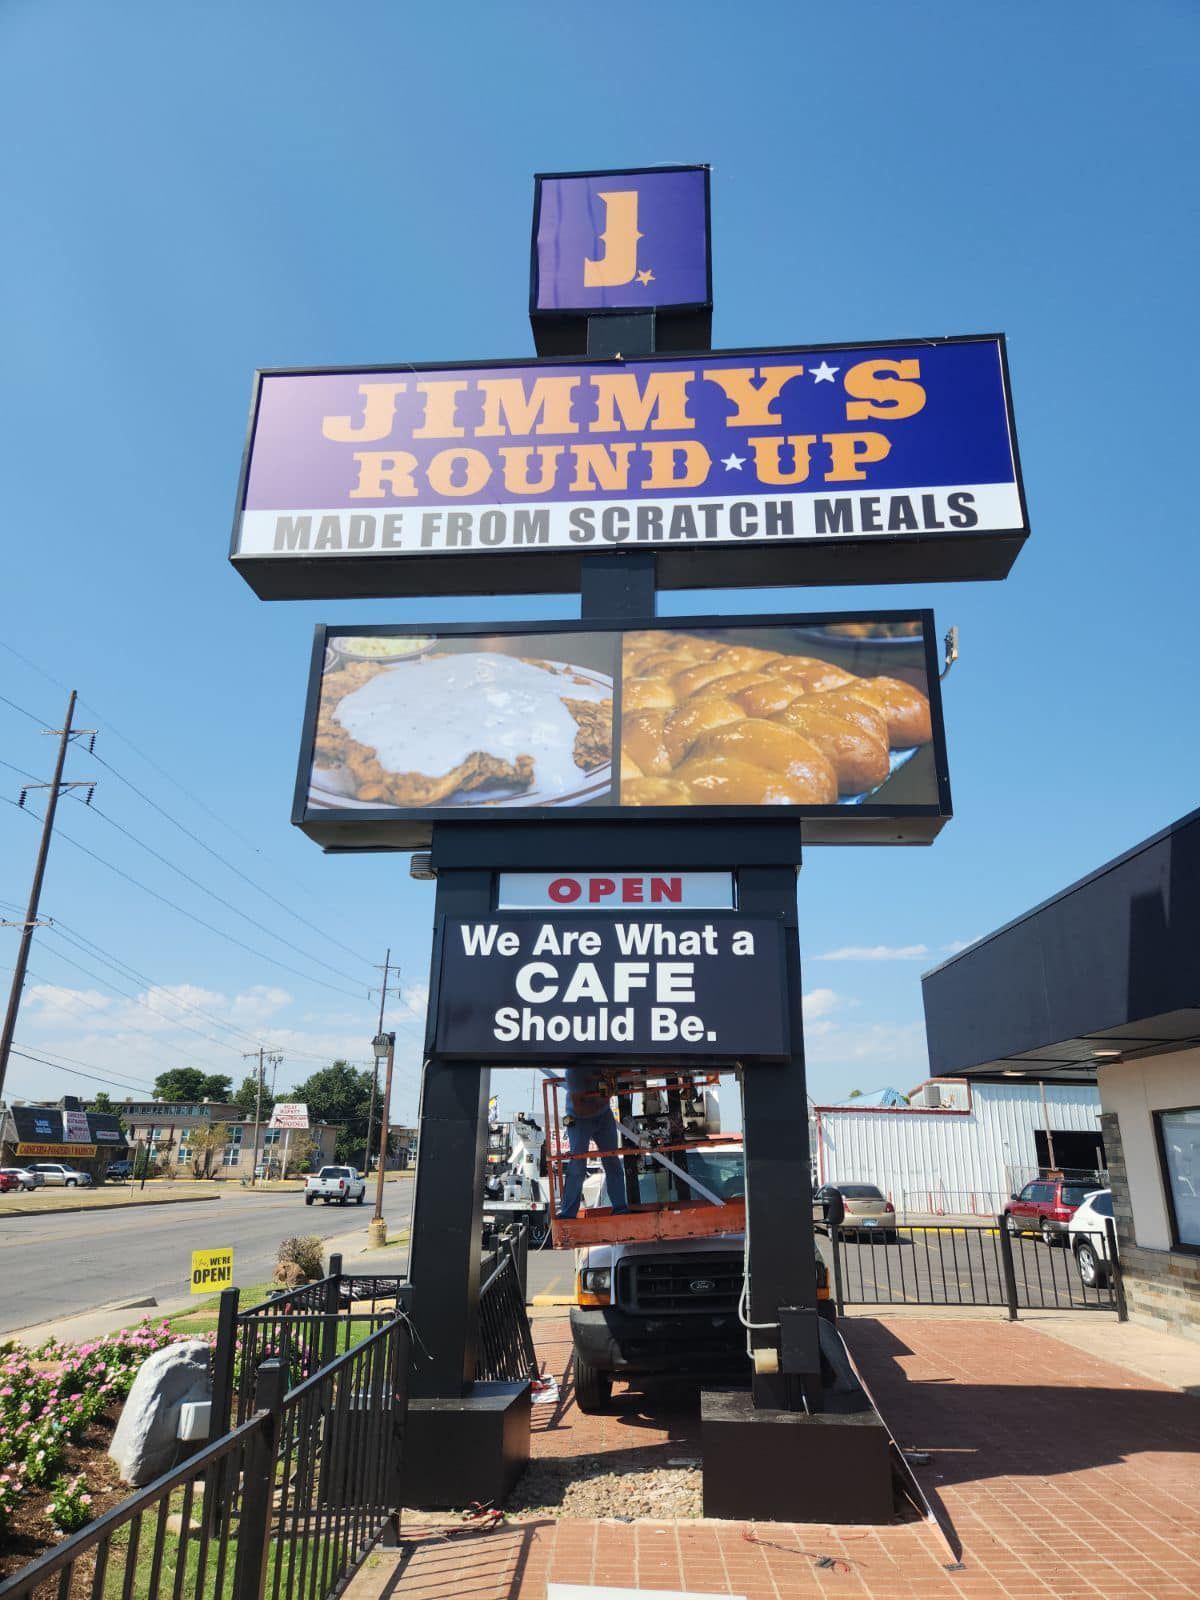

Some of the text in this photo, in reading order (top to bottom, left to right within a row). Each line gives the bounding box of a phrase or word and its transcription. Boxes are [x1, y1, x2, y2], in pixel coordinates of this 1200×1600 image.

[274, 492, 979, 549] MADE FROM SCRATCH MEALS
[549, 878, 681, 903] OPEN
[460, 923, 755, 957] We Are What a
[515, 961, 696, 1004] CAFE
[493, 1006, 717, 1042] Should Be.
[193, 1266, 231, 1284] OPEN!
[209, 1256, 231, 1266] WE'RE
